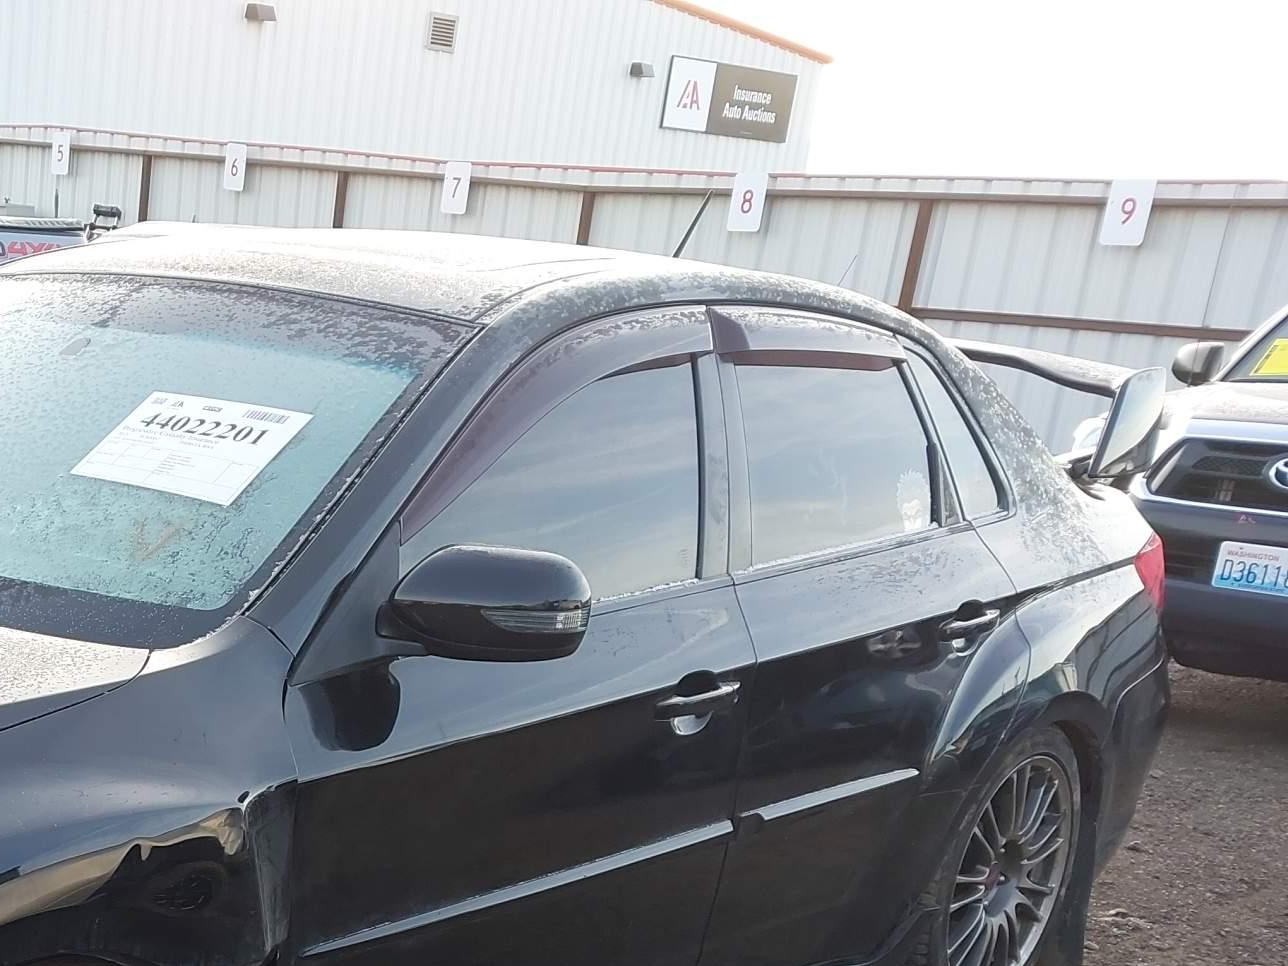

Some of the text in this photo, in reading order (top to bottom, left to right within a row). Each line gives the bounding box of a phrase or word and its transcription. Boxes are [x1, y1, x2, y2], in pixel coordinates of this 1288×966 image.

[733, 84, 772, 105] Insurance
[722, 102, 777, 124] Auto Auctions
[57, 144, 64, 162] 5
[230, 158, 239, 177] 6
[451, 176, 462, 198] 7
[740, 189, 754, 214] 8
[1121, 197, 1137, 225] 9
[140, 412, 270, 445] 44022201
[1227, 550, 1280, 562] WASHINGTON
